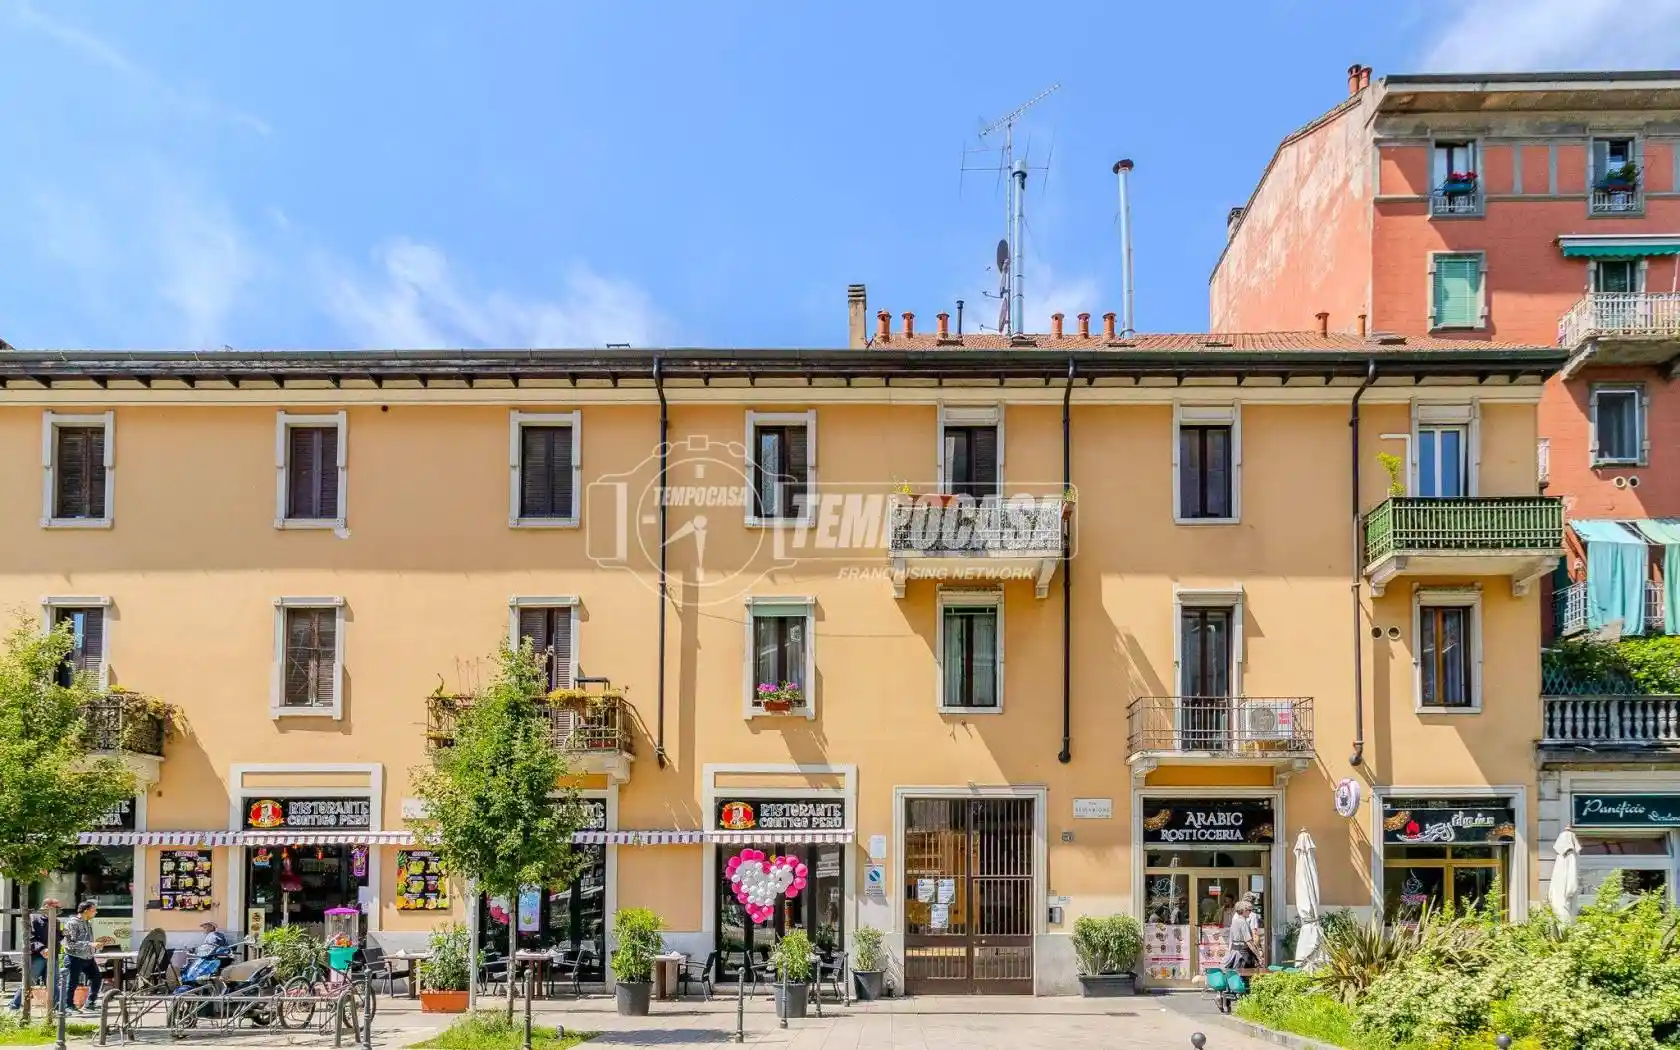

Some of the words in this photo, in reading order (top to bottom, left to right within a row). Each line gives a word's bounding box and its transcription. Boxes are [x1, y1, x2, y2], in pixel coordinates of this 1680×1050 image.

[288, 801, 369, 815] RISTORANTE
[760, 803, 842, 817] RISTORANTE
[1582, 799, 1646, 818] Panificio
[287, 814, 337, 826] CONTIGO
[759, 817, 809, 828] CONTIGO
[1160, 829, 1243, 842] ROSTICCERIA
